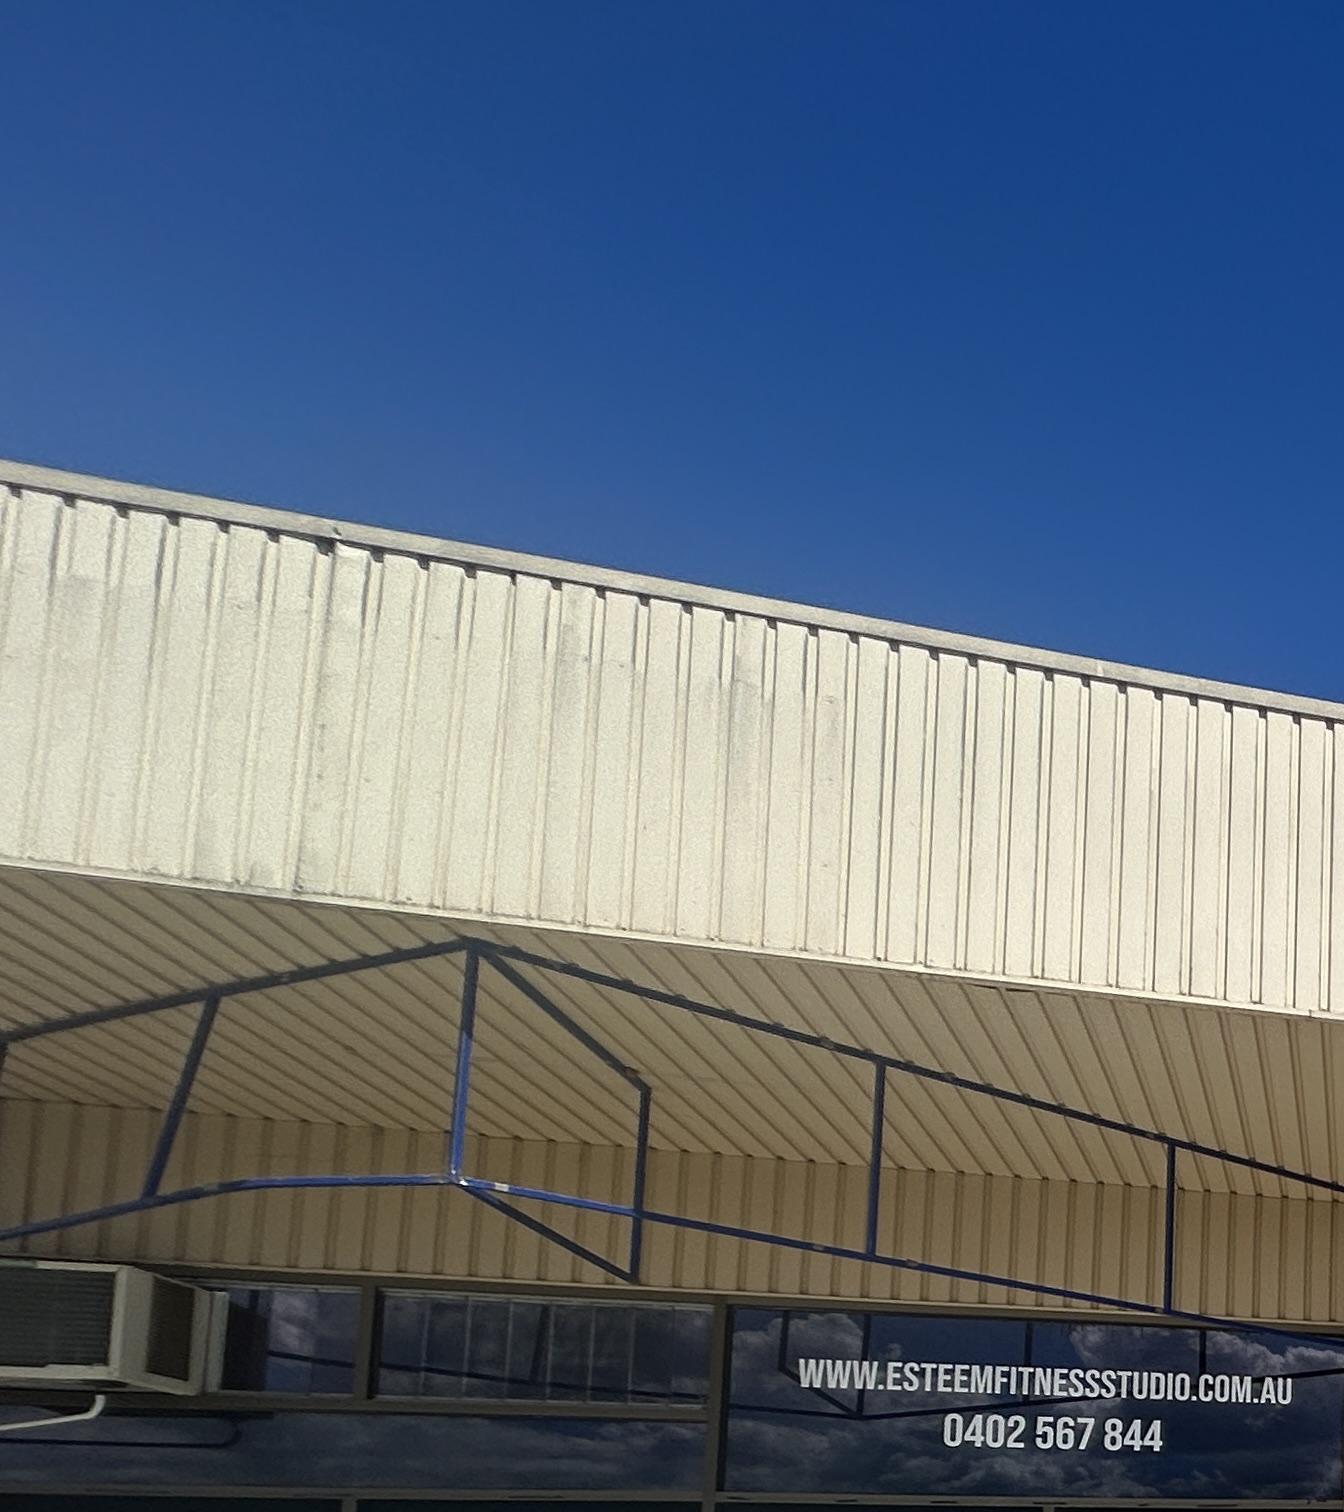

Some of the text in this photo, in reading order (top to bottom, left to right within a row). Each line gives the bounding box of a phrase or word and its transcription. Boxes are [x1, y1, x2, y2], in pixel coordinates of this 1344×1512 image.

[798, 1357, 1294, 1406] WWW.ESTEEMFITNESSSTUDIO.COM.AU
[942, 1412, 1164, 1454] 0402 567 844
